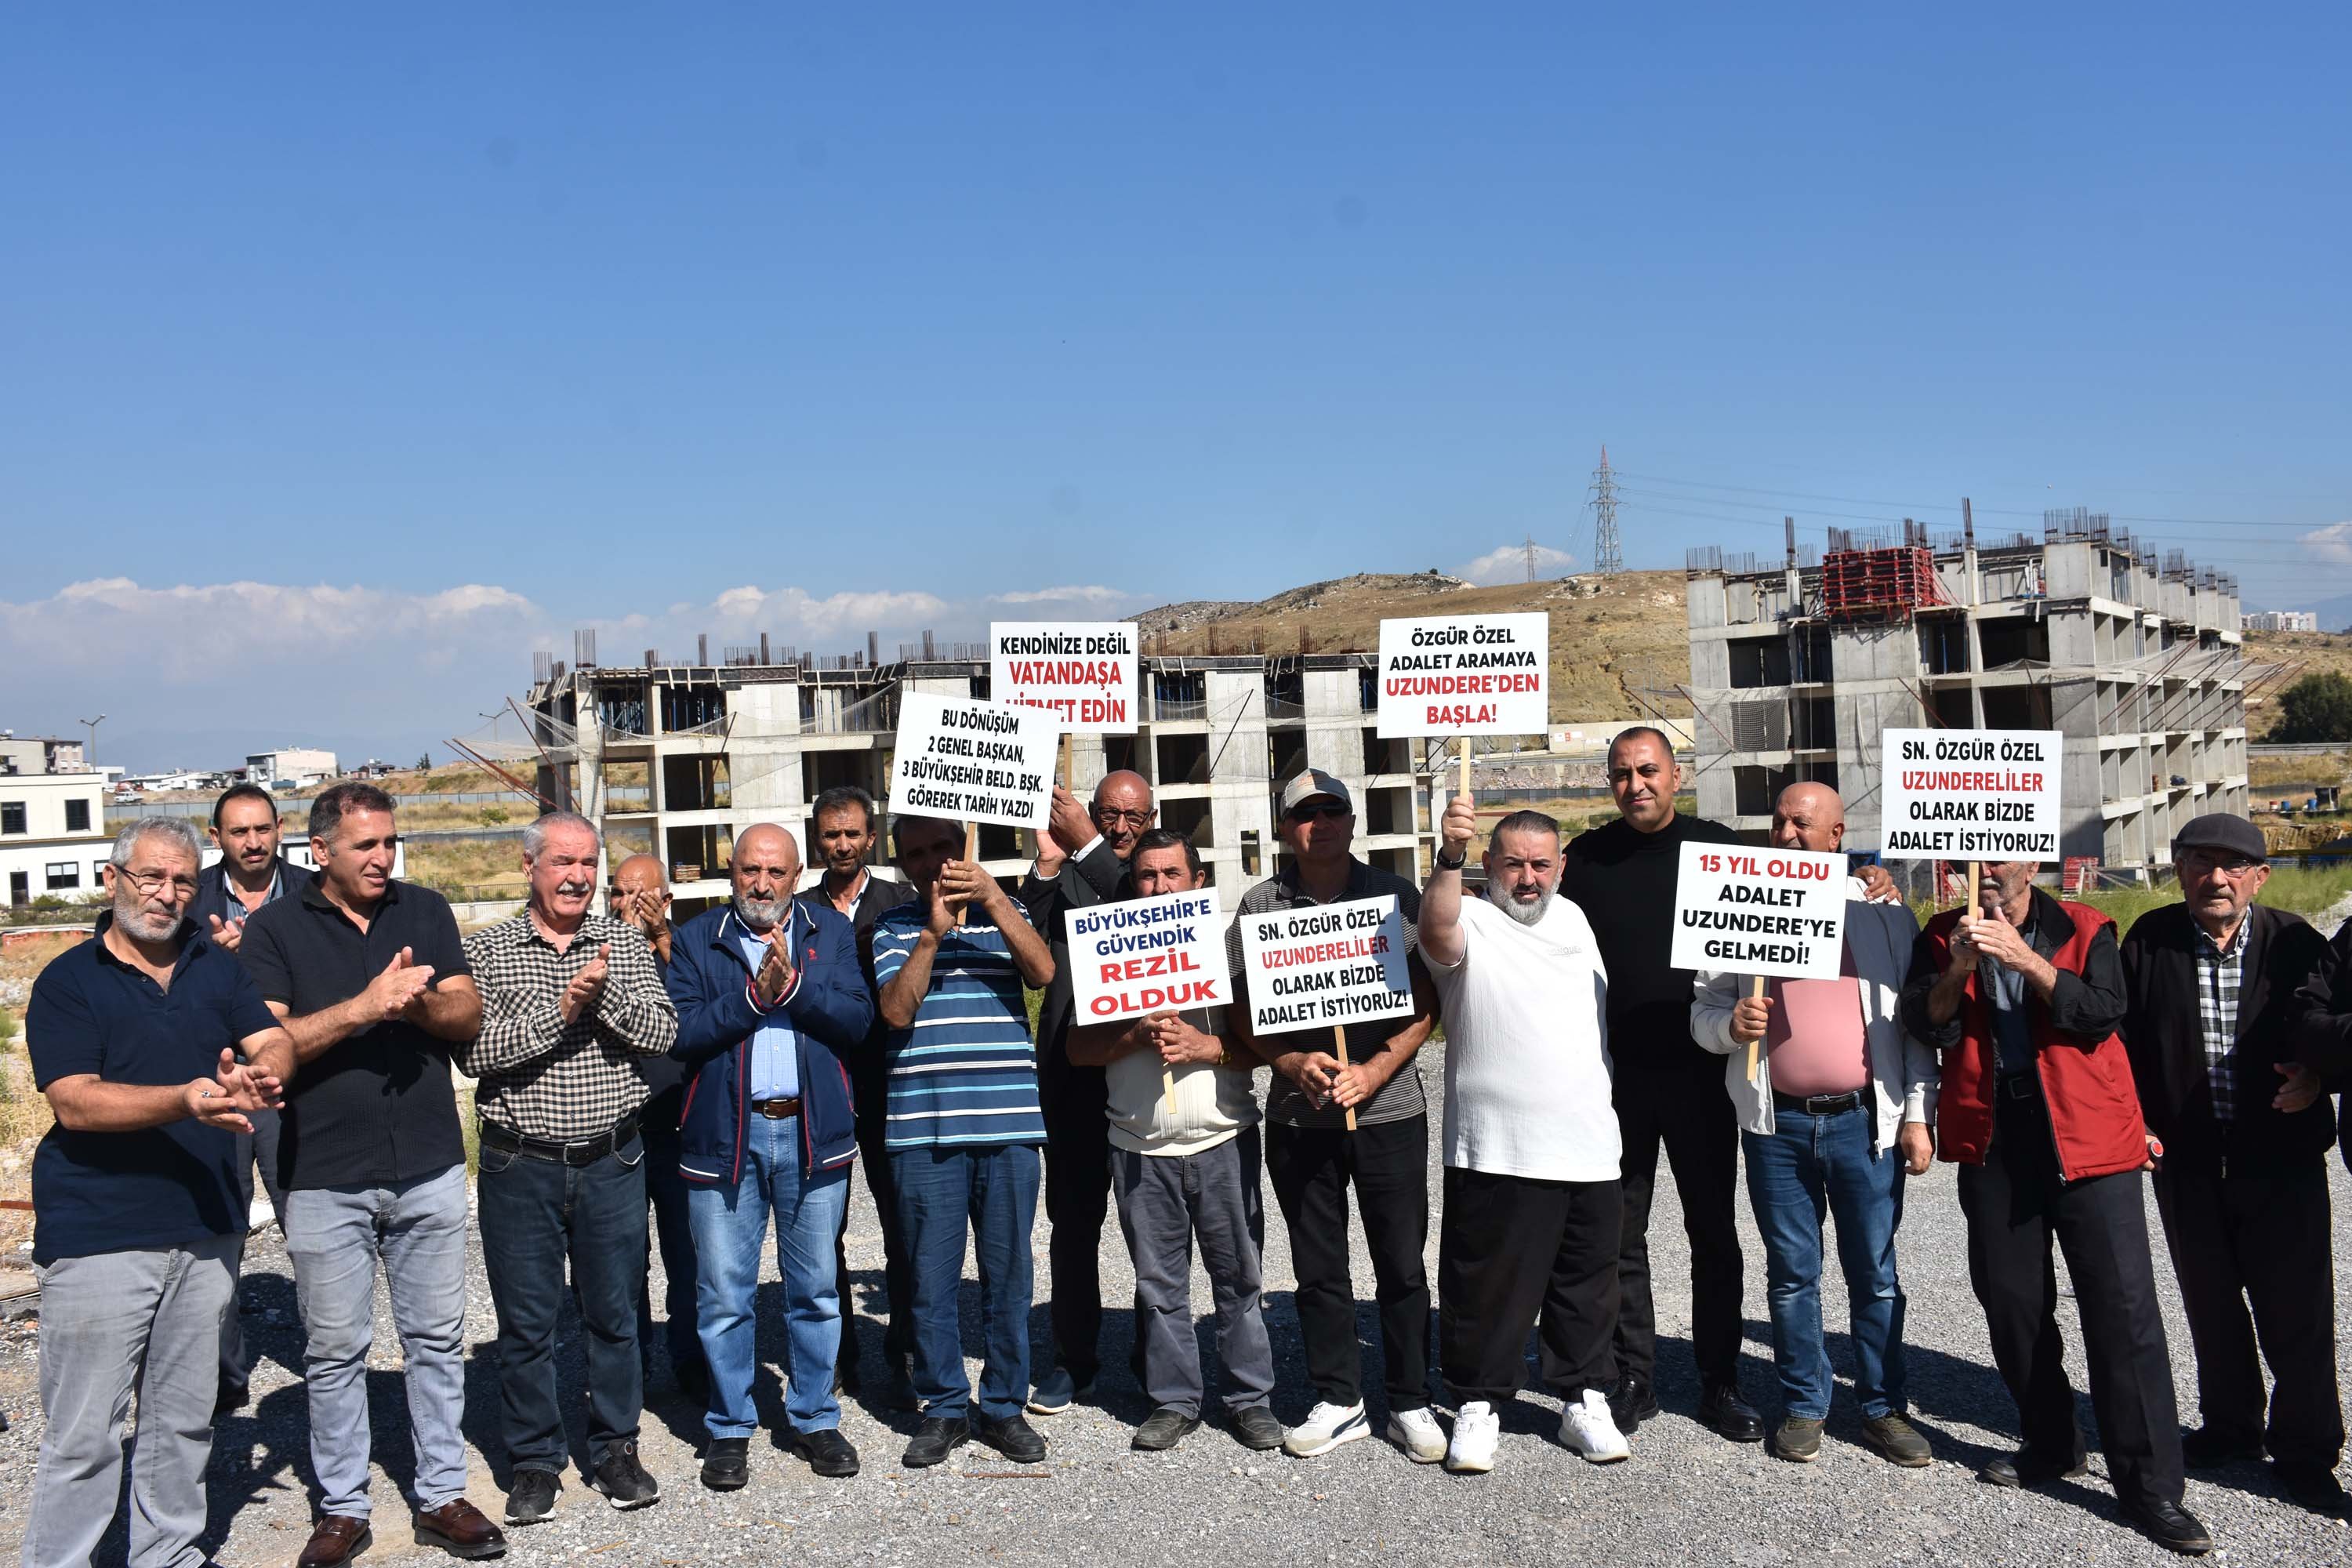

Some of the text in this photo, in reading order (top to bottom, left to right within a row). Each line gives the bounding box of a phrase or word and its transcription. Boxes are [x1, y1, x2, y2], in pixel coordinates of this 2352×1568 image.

[1000, 631, 1131, 655] KENDİNİZE DEĞİL
[1411, 624, 1515, 647] ÖZGÜR ÖZEL
[1009, 661, 1123, 691] VATANDAŞA
[1389, 651, 1537, 671] ADALET ARAMAYA
[1386, 673, 1539, 696] UZUNDERE'DEN
[941, 707, 1019, 737] BU DÖNÜŞÜM
[1081, 691, 1126, 723] EDİN
[1427, 703, 1497, 728] BAŞLA!
[927, 735, 1025, 766] 2 GENEL BAŞKAN,
[1902, 737, 2045, 762] SN. ÖZGÜR ÖZEL
[902, 756, 1044, 796] 3 BÜYÜKŞEHİR BELD. BŞK.
[1903, 768, 2043, 792] UZUNDERELİLER
[907, 783, 1034, 818] GÖREREK TARİH YAZDI
[1909, 797, 2034, 822] OLARAK BİZDE
[1887, 827, 2054, 852] ADALET İSTİYORUZ!
[1699, 855, 1829, 881] 15 YIL OLDU
[1718, 884, 1806, 908] ADALET
[1075, 898, 1211, 935] BÜYÜKŞEHİR'E
[1258, 907, 1387, 942] SN. ÖZGÜR ÖZEL
[1682, 909, 1836, 938] UZUNDERE'YE
[1096, 924, 1197, 956] GÜVENDİK
[1261, 935, 1391, 969] UZUNDERELİLER
[1704, 939, 1810, 965] GELMEDİ!
[1100, 947, 1200, 984] REZİL
[1272, 963, 1387, 996] OLARAK BİZDE
[1091, 979, 1218, 1016] OLDUK
[1258, 993, 1408, 1026] ADALET İSTİYORUZ!
